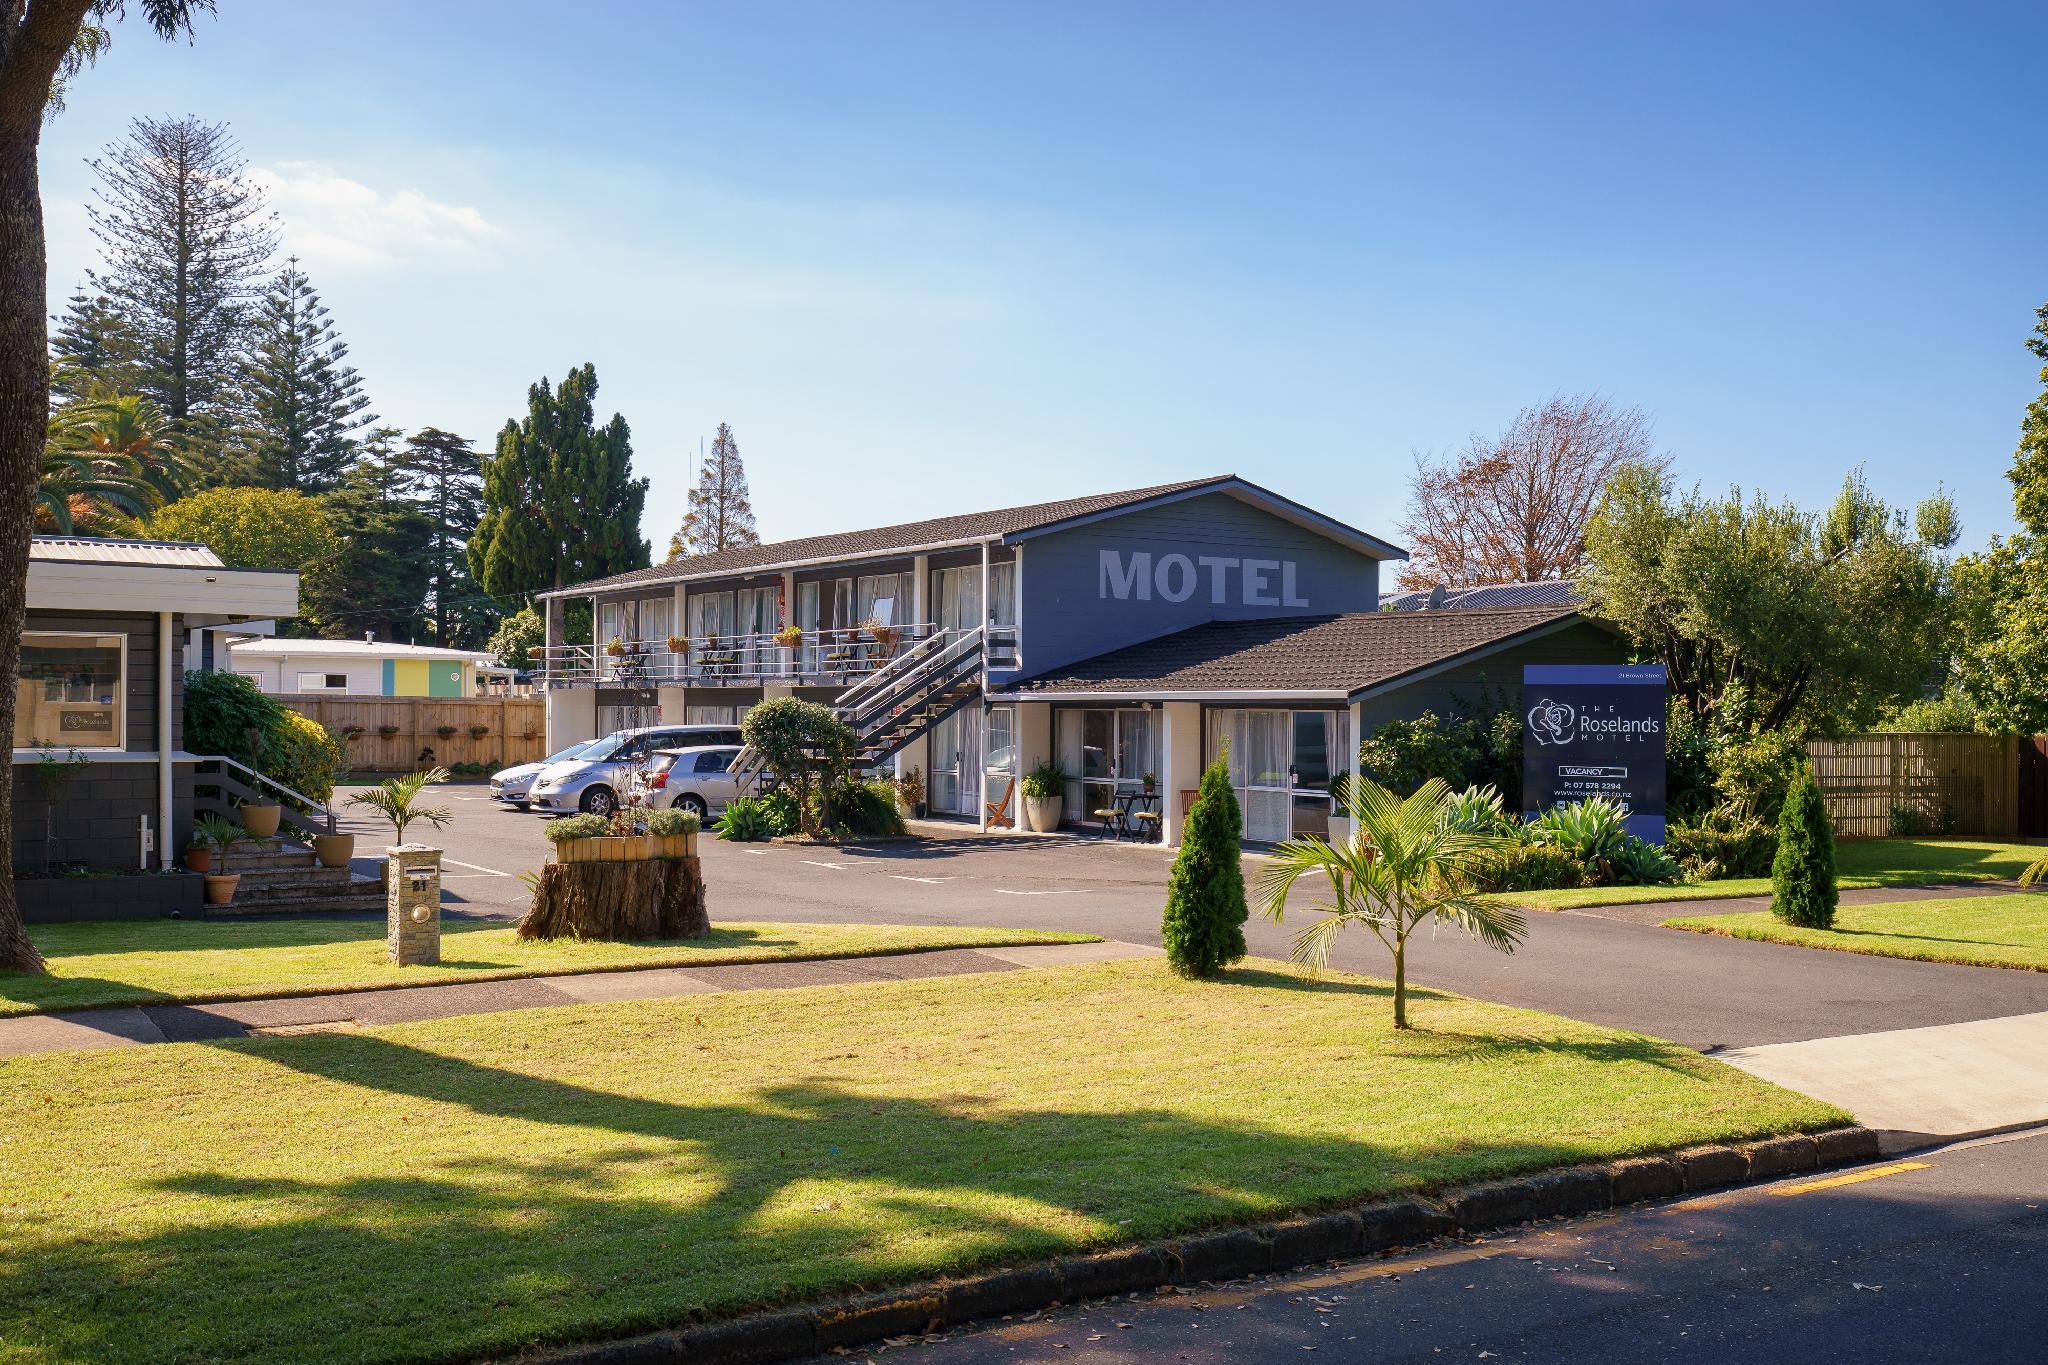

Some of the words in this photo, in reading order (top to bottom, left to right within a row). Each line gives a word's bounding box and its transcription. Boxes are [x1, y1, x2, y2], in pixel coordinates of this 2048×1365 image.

[1099, 549, 1310, 608] MOTEL
[1582, 705, 1614, 713] THE
[1580, 716, 1659, 733] Roselands
[1581, 734, 1645, 742] MOTEL
[1565, 767, 1603, 776] VACANCY
[412, 881, 426, 891] 21
